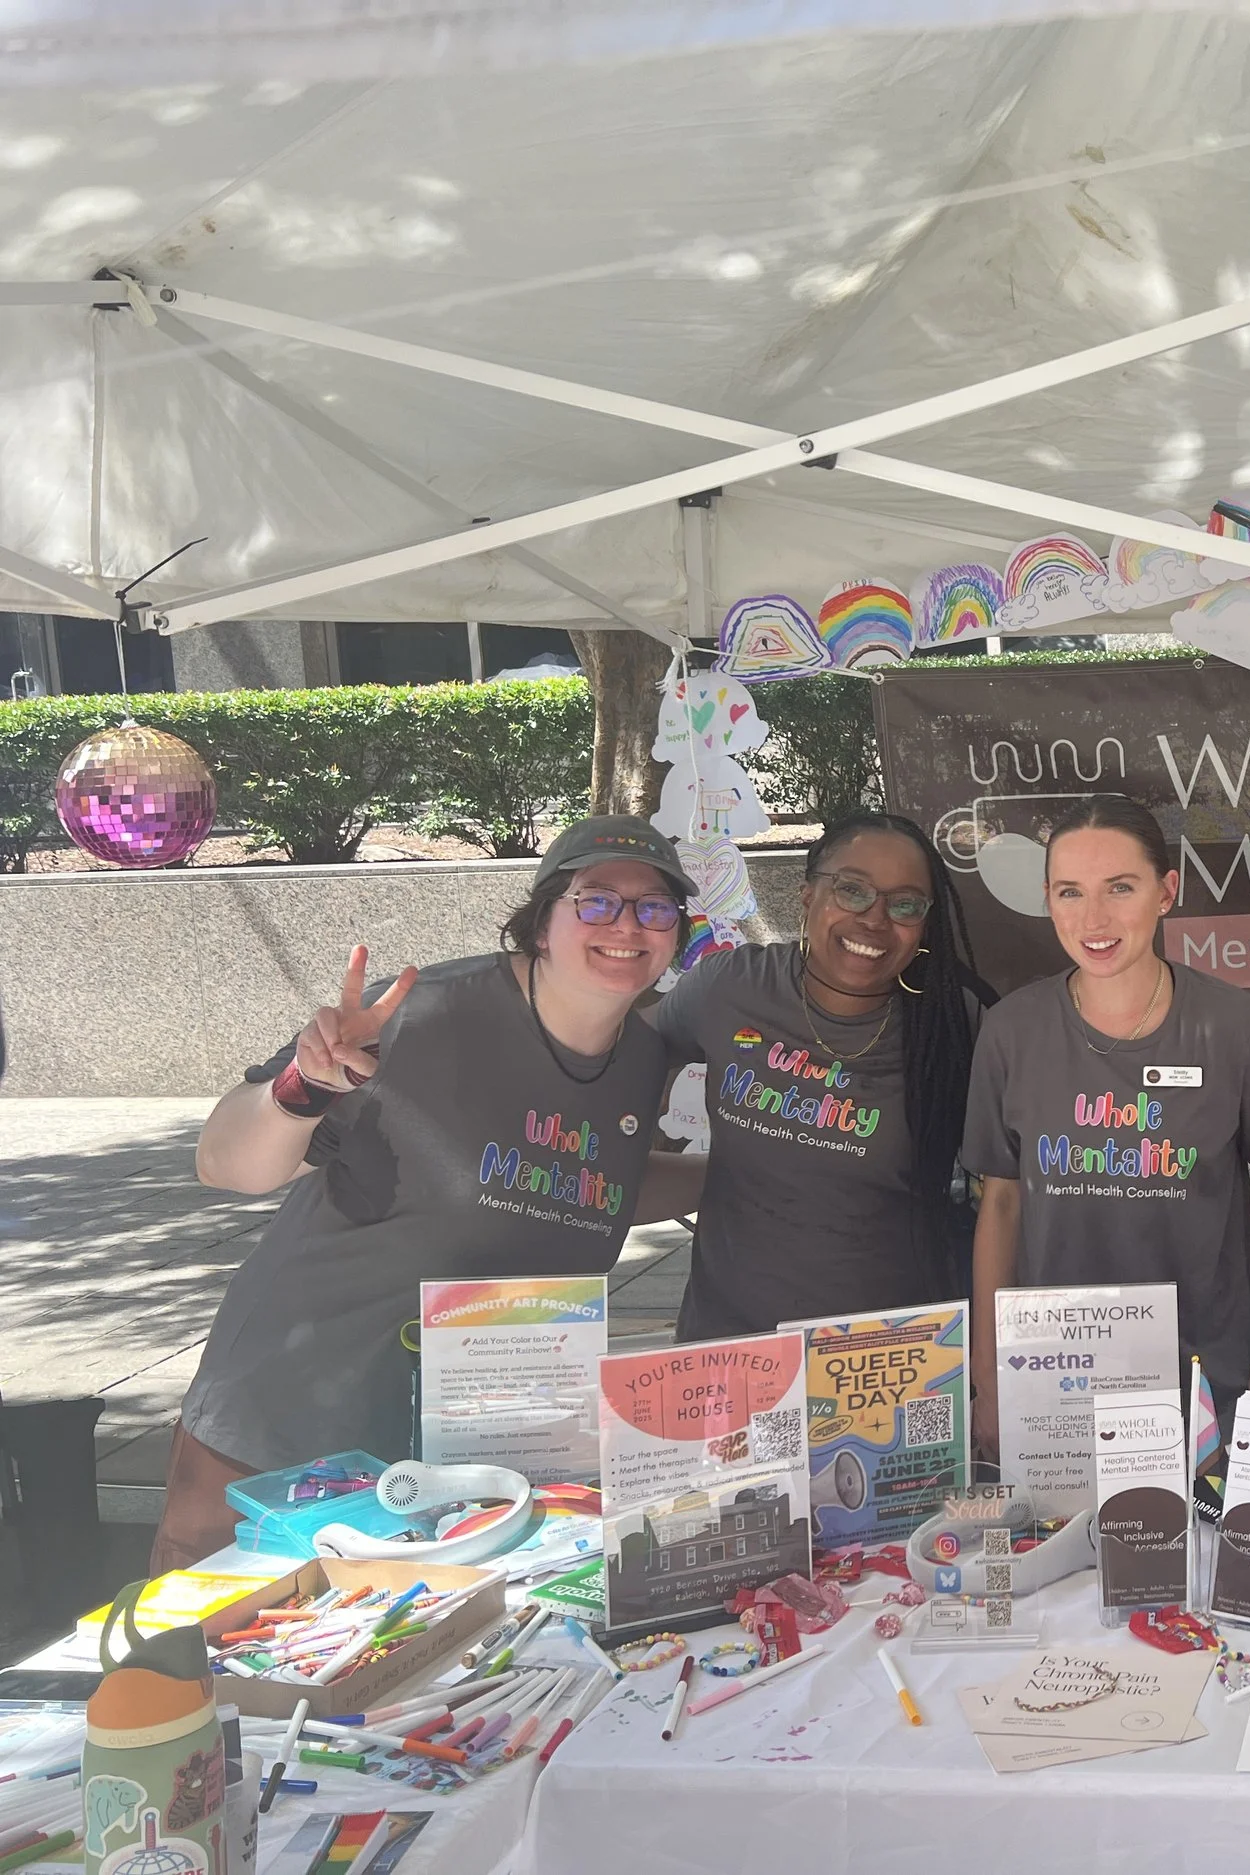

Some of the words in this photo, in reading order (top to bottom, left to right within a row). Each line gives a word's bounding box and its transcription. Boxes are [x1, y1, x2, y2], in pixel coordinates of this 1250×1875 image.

[842, 577, 874, 591] PRIDE
[1046, 573, 1066, 584] belong
[1043, 586, 1071, 602] ALWAYS
[710, 917, 726, 936] You
[719, 1062, 881, 1138] Mentality
[1074, 1091, 1163, 1132] Whole
[525, 1109, 600, 1161] Whole
[717, 1105, 751, 1129] Mental
[752, 1122, 794, 1142] Health
[796, 1132, 867, 1157] Counseling
[1037, 1134, 1198, 1180] Mentality
[479, 1141, 624, 1216] Mentality
[1046, 1182, 1084, 1196] Mental
[1087, 1183, 1124, 1198] Health
[1126, 1185, 1187, 1201] Counseling
[478, 1192, 524, 1215] Mental
[525, 1203, 561, 1224] Health
[563, 1213, 613, 1238] Counseling
[429, 1296, 511, 1325] COMMUNITY
[512, 1297, 539, 1308] ART
[540, 1298, 600, 1320] PROJECT
[1018, 1310, 1038, 1324] IN
[1047, 1305, 1155, 1323] NETWORK
[471, 1336, 489, 1346] Add
[489, 1336, 510, 1346] Your
[510, 1335, 532, 1345] Color
[532, 1335, 542, 1344] to
[541, 1335, 557, 1343] Our
[1060, 1324, 1113, 1340] WITH
[467, 1347, 515, 1359] Community
[515, 1345, 552, 1356] Rainbow!
[1028, 1351, 1095, 1371] aetna
[825, 1347, 927, 1379] QUEER
[624, 1356, 696, 1394] YOU'RE
[702, 1352, 781, 1376] INVITED!
[835, 1367, 918, 1394] FIELD
[1090, 1375, 1124, 1383] BlueCross
[682, 1383, 728, 1401] OPEN
[847, 1386, 907, 1411] DAY
[678, 1400, 734, 1421] HOUSE
[1027, 1422, 1088, 1432] (INCLUDING
[1118, 1417, 1157, 1429] WHOLE
[1048, 1430, 1089, 1440] HEALTH
[1118, 1427, 1178, 1440] MENTALITY
[707, 1431, 748, 1457] RSVP
[618, 1453, 638, 1463] Tour
[639, 1450, 652, 1460] the
[653, 1447, 679, 1458] space
[722, 1444, 749, 1465] Here
[879, 1446, 949, 1467] SATURDAY
[1018, 1452, 1052, 1461] Contact
[1053, 1451, 1065, 1460] Us
[1065, 1450, 1092, 1460] Today
[1104, 1455, 1136, 1466] Healing
[1136, 1452, 1176, 1463] Centered
[619, 1465, 642, 1475] Meet
[642, 1462, 657, 1472] the
[658, 1455, 699, 1470] therapists
[871, 1463, 927, 1481] JUNE
[1027, 1468, 1042, 1477] For
[1043, 1468, 1063, 1478] your
[1065, 1467, 1084, 1476] free
[1101, 1465, 1130, 1475] Mental
[1130, 1463, 1159, 1473] Health
[1159, 1462, 1180, 1471] Care
[619, 1478, 651, 1488] Explore
[653, 1474, 666, 1484] the
[667, 1470, 690, 1481] vibes
[982, 1484, 1016, 1499] GET
[943, 1499, 1006, 1521] Social
[1100, 1519, 1144, 1532] Affirming
[1123, 1530, 1165, 1541] Inclusive
[1134, 1540, 1185, 1553] Accessible
[1039, 1655, 1061, 1667] Is
[1062, 1656, 1110, 1668] Your
[1032, 1666, 1114, 1680] Chronic
[1115, 1671, 1159, 1684] Pain
